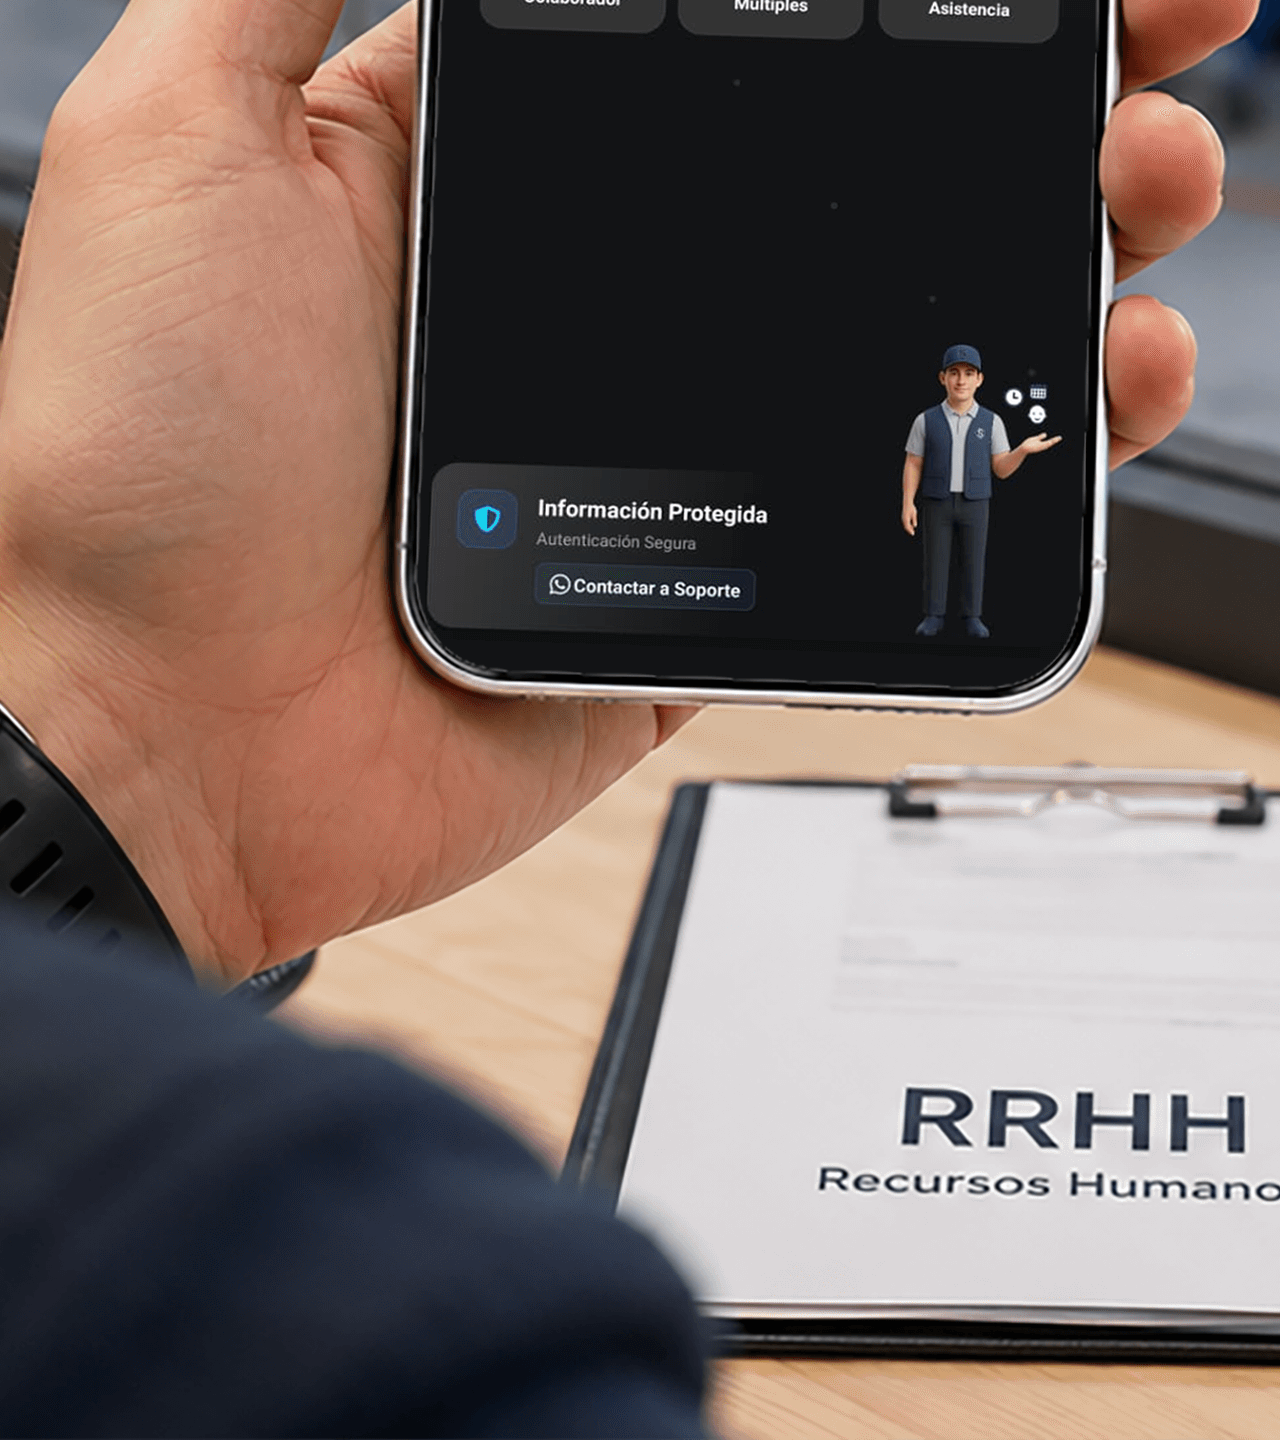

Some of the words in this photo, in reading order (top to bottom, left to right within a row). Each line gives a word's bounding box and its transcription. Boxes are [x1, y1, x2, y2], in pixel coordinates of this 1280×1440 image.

[928, 1, 1010, 17] Asistencia
[538, 498, 663, 521] Información
[668, 502, 768, 527] Protegida
[535, 531, 640, 549] Autenticación
[643, 534, 697, 553] Segura
[573, 578, 656, 596] Contactar
[659, 584, 670, 596] a
[674, 581, 741, 601] Soporte
[901, 1087, 1246, 1154] RRHH
[818, 1167, 1050, 1197] Recursos
